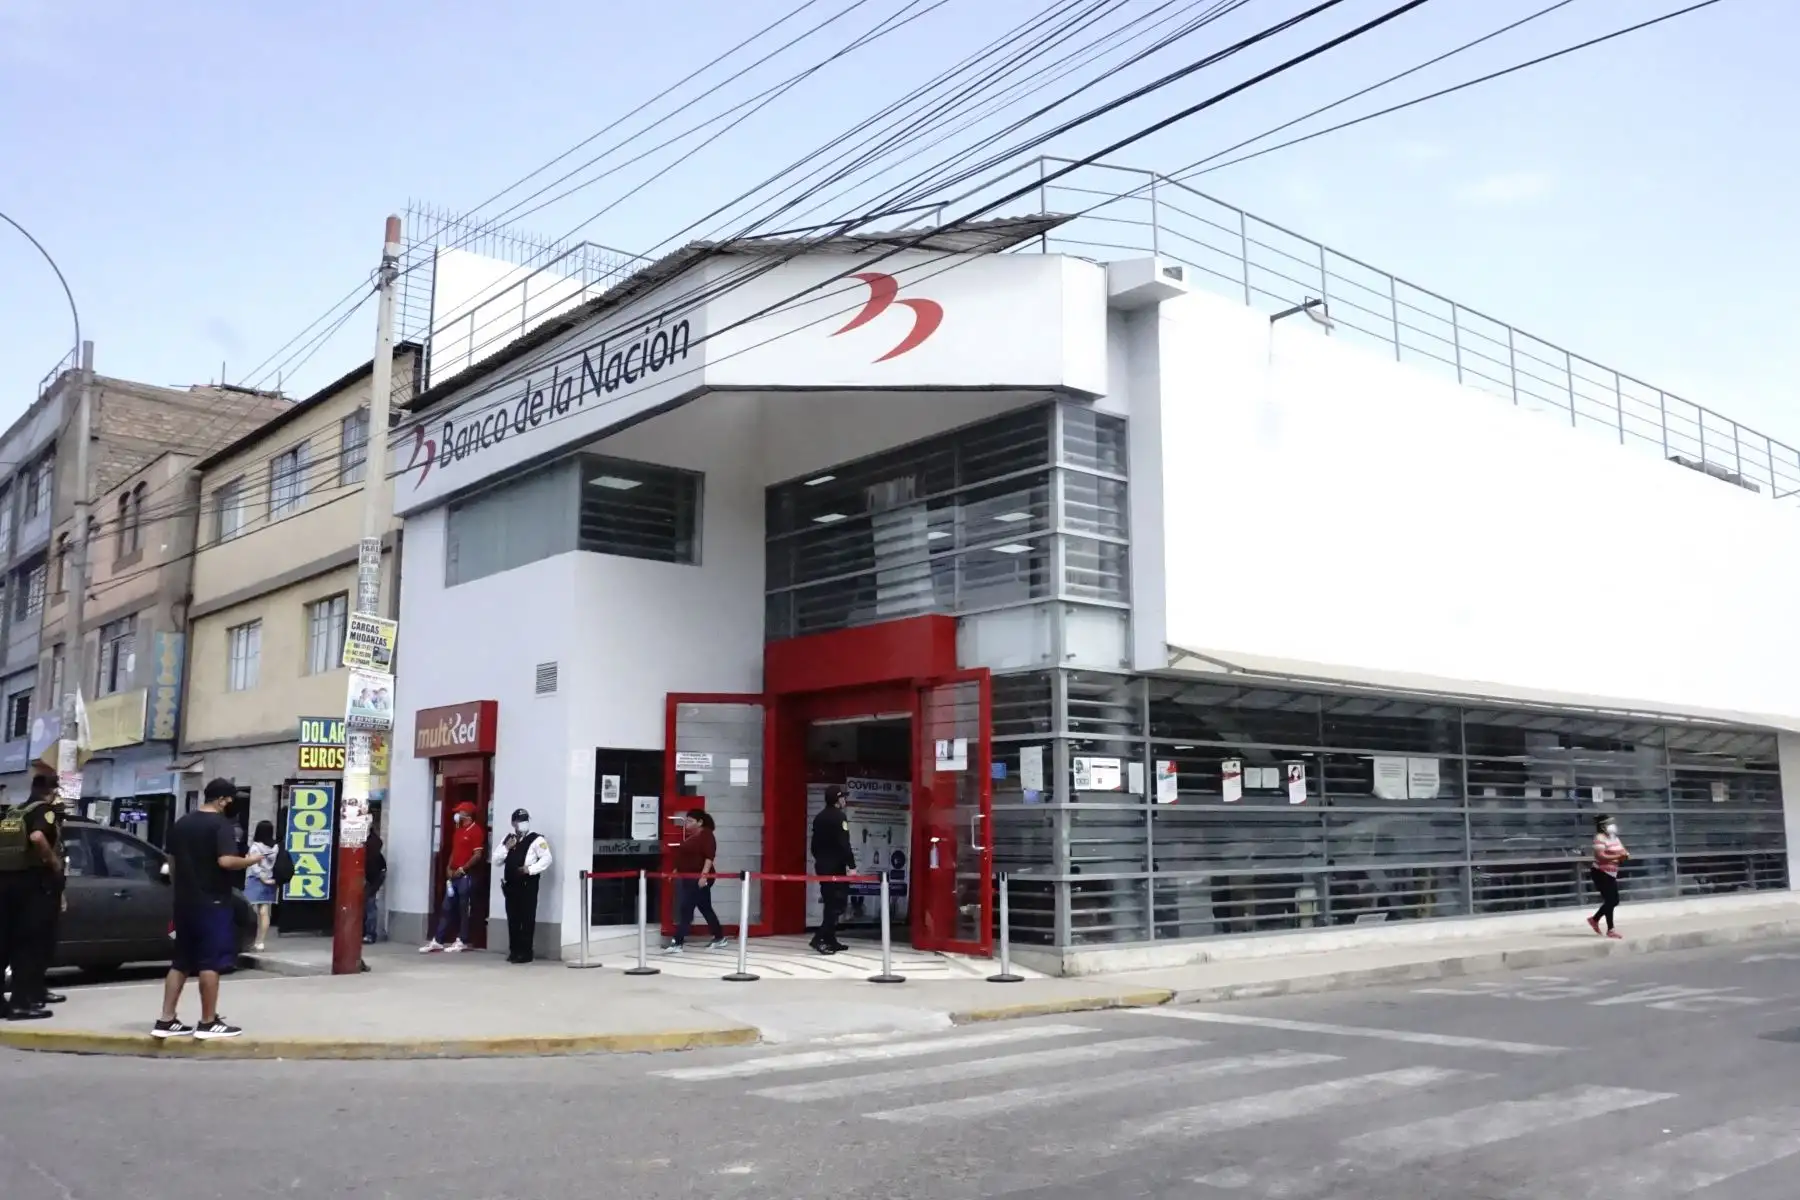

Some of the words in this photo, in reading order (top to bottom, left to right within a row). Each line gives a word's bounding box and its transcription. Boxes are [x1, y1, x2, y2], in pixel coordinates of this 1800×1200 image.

[440, 421, 507, 469] Banco
[515, 379, 543, 433] de
[549, 366, 572, 419] la
[579, 311, 690, 406] Nación
[351, 620, 380, 634] CARGAS
[350, 631, 388, 647] MUDANZAS
[302, 720, 345, 744] DOLAR
[301, 747, 345, 768] EUROS
[847, 780, 892, 792] COVID-19
[287, 789, 328, 898] DOLAR
